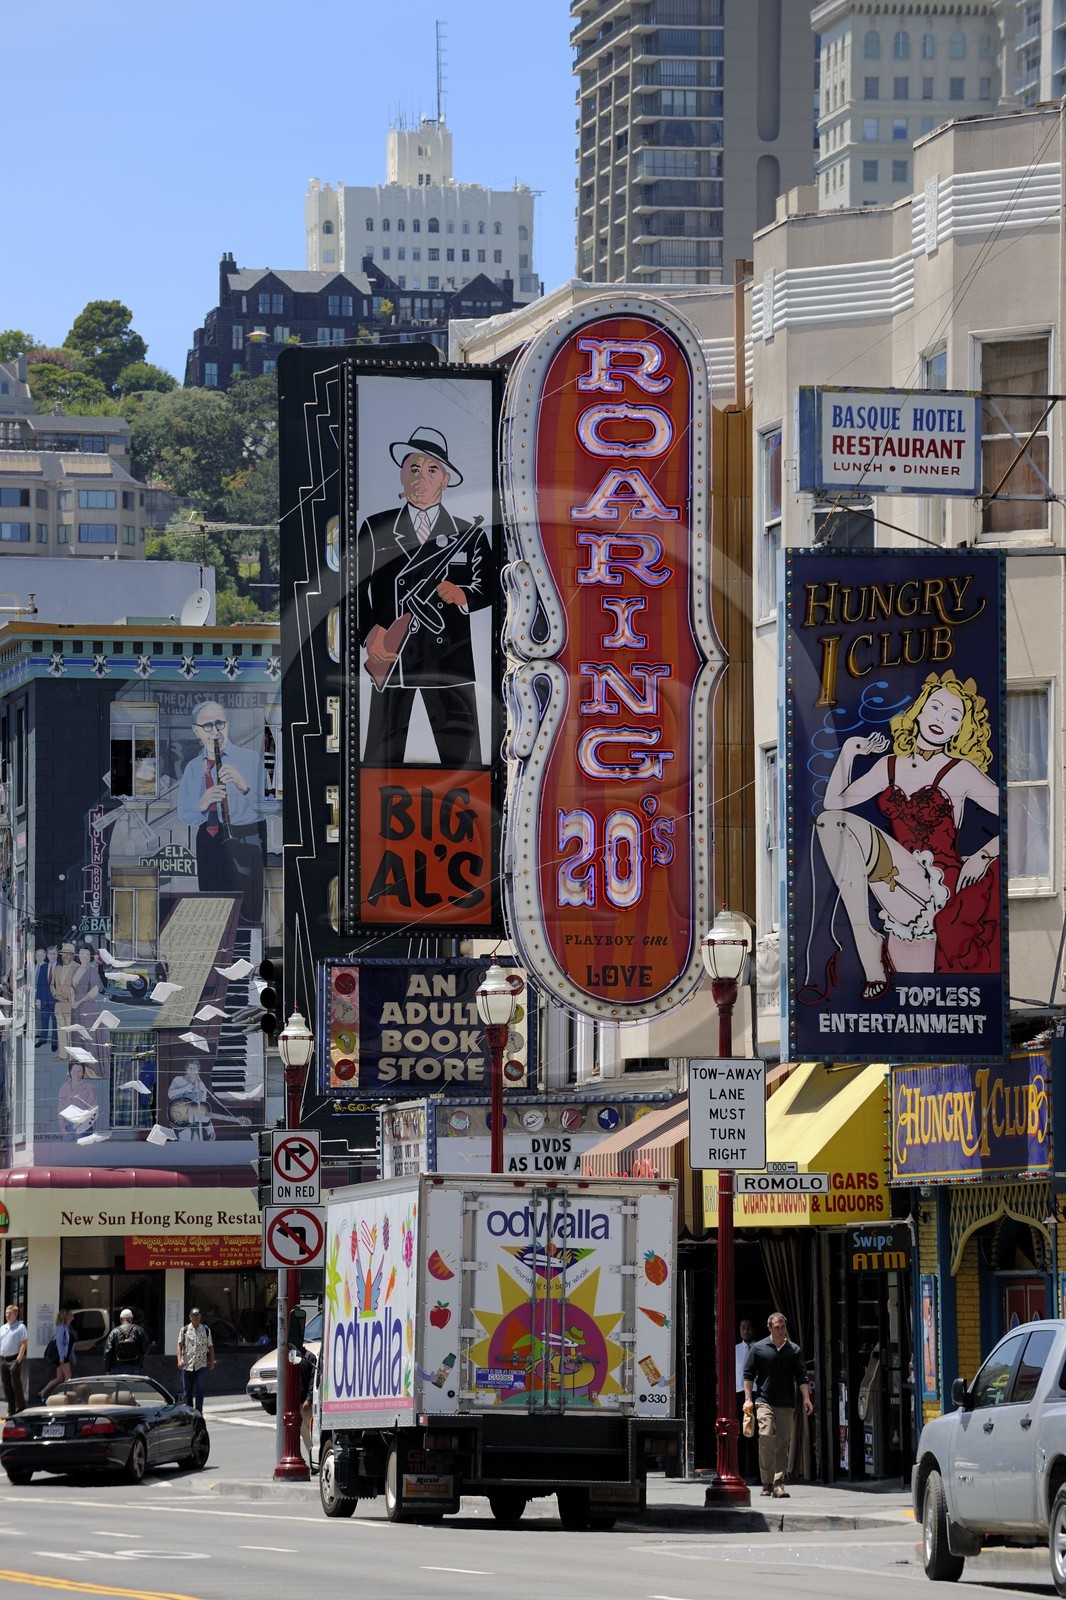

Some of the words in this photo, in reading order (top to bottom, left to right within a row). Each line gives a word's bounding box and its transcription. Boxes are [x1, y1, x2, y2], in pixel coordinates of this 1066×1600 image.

[832, 404, 900, 431] BASQUE
[912, 407, 966, 433] HOTEL
[832, 434, 966, 459] RESTAURANT
[833, 461, 882, 473] LUNCH
[903, 464, 960, 475] DINNER
[570, 336, 682, 784] ROARING
[802, 574, 988, 627] HUNGRY
[816, 634, 842, 708] I
[847, 625, 955, 678] CLUB
[157, 693, 176, 704] THE
[178, 692, 225, 708] CASTLE
[227, 693, 264, 708] HOTEL
[378, 785, 478, 843] BIG
[92, 813, 101, 862] MULIN
[367, 844, 485, 909] AL'S
[92, 868, 101, 909] ROUGE
[564, 935, 635, 946] PLAYBOY
[642, 935, 668, 946] GIRL
[406, 974, 456, 998] AN
[586, 965, 653, 987] LOVE
[896, 986, 981, 1007] TOPLESS
[379, 1002, 479, 1026] ADULT
[819, 1013, 987, 1035] ENTERTAINMENT
[381, 1029, 482, 1053] BOOK
[377, 1057, 485, 1081] STORE
[692, 1068, 762, 1080] TOW-AWAY
[709, 1088, 745, 1100] LANE
[709, 1108, 746, 1120] MUST
[897, 1084, 983, 1166] HUNGRY
[975, 1068, 991, 1157] I
[991, 1075, 1048, 1143] CLUB
[710, 1128, 746, 1140] TURN
[531, 1138, 572, 1153] DVDS
[708, 1148, 747, 1160] RIGHT
[508, 1156, 528, 1172] AS
[535, 1156, 567, 1171] LOW
[772, 1163, 787, 1171] 000
[744, 1177, 823, 1190] ROMOLO
[829, 1172, 879, 1190] GARS
[277, 1186, 291, 1198] ON
[295, 1186, 315, 1198] RED
[811, 1197, 821, 1212] &
[825, 1194, 884, 1213] LIQUORS
[60, 1211, 94, 1226] New
[98, 1211, 126, 1226] Sun
[130, 1211, 171, 1228] Hong
[174, 1210, 213, 1228] Kong
[486, 1206, 610, 1240] odwalla
[852, 1231, 894, 1251] Swipe
[852, 1251, 906, 1270] ATM
[513, 1265, 542, 1291] nourishg
[572, 1268, 589, 1284] whole
[333, 1306, 403, 1399] odwalla
[647, 1394, 668, 1404] 330
